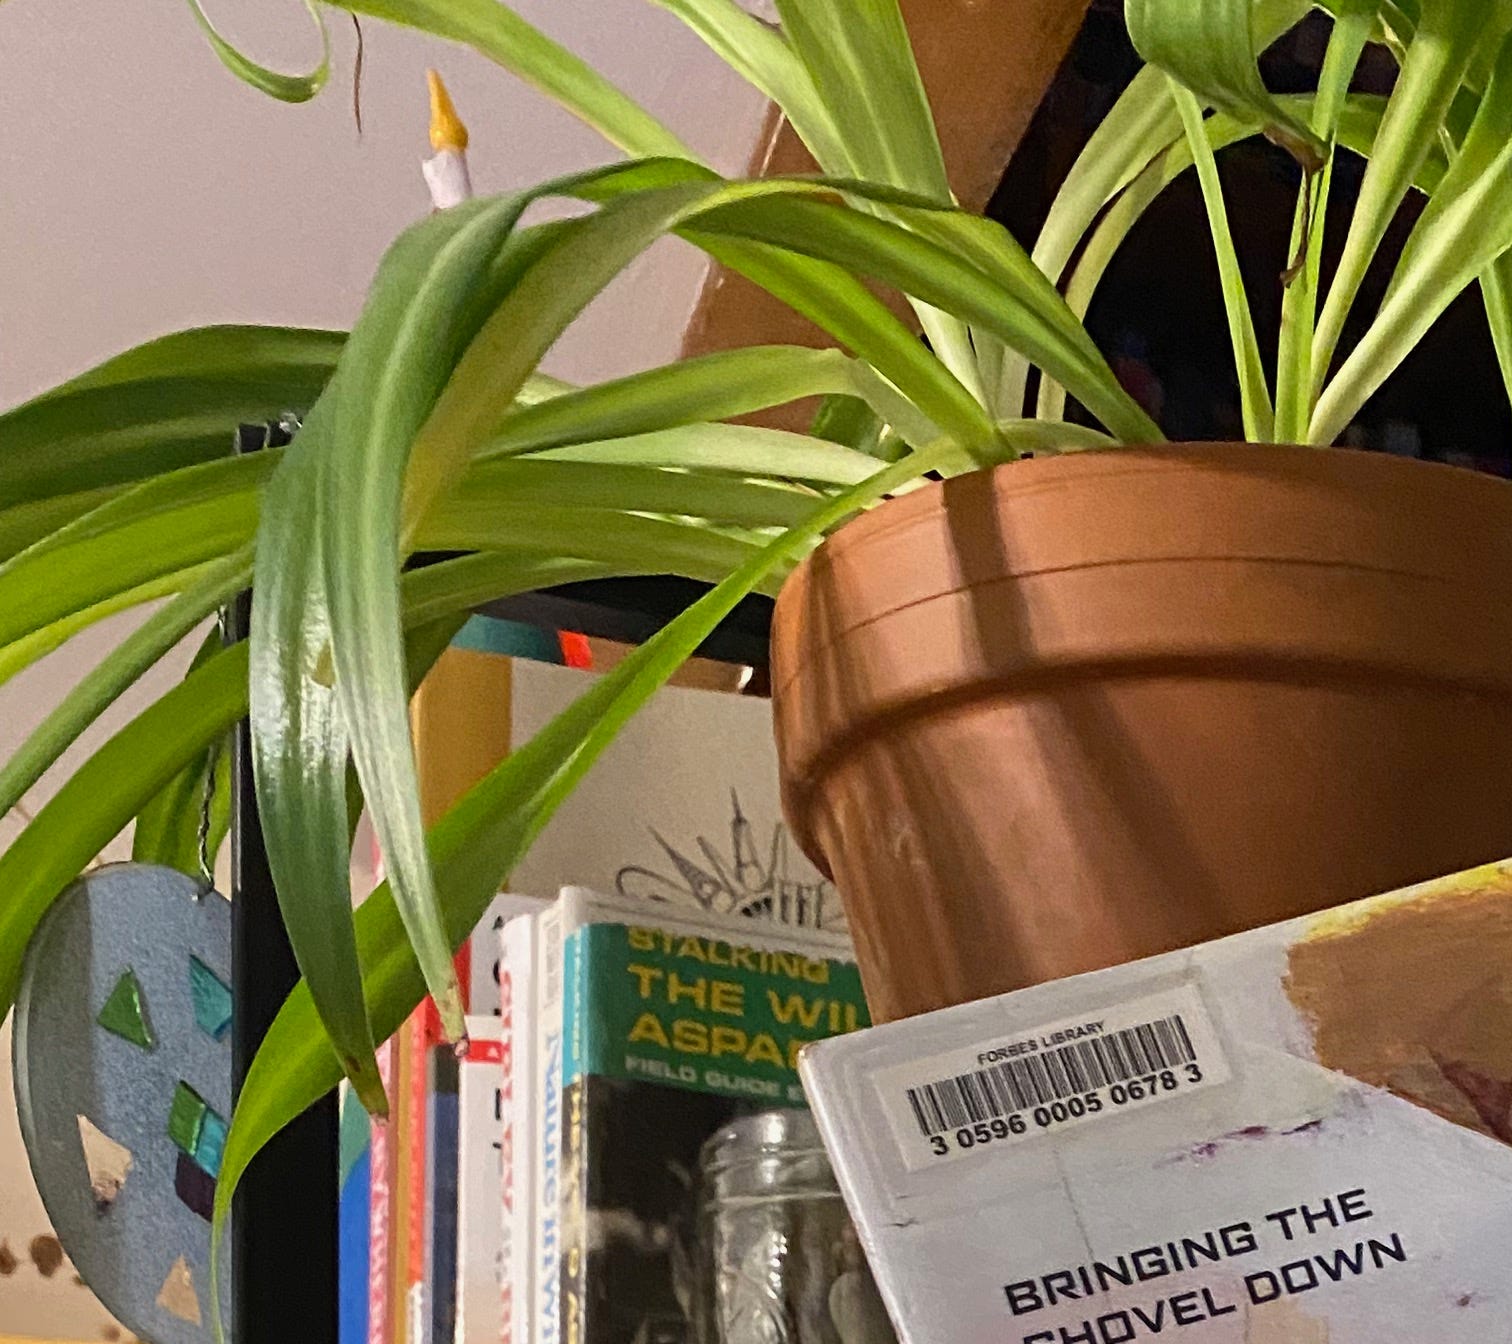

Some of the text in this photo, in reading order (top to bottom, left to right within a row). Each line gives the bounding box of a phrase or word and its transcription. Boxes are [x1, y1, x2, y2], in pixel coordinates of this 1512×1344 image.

[626, 964, 746, 1018] THE
[977, 1020, 1105, 1065] FORBES LIBRARY
[625, 1055, 698, 1083] FIELD
[704, 1071, 781, 1097] GUIDE
[929, 1063, 1204, 1157] 3 0596 0005 0678 3
[1003, 1188, 1374, 1316] BRINGING THE
[1244, 1232, 1408, 1306] DOWN
